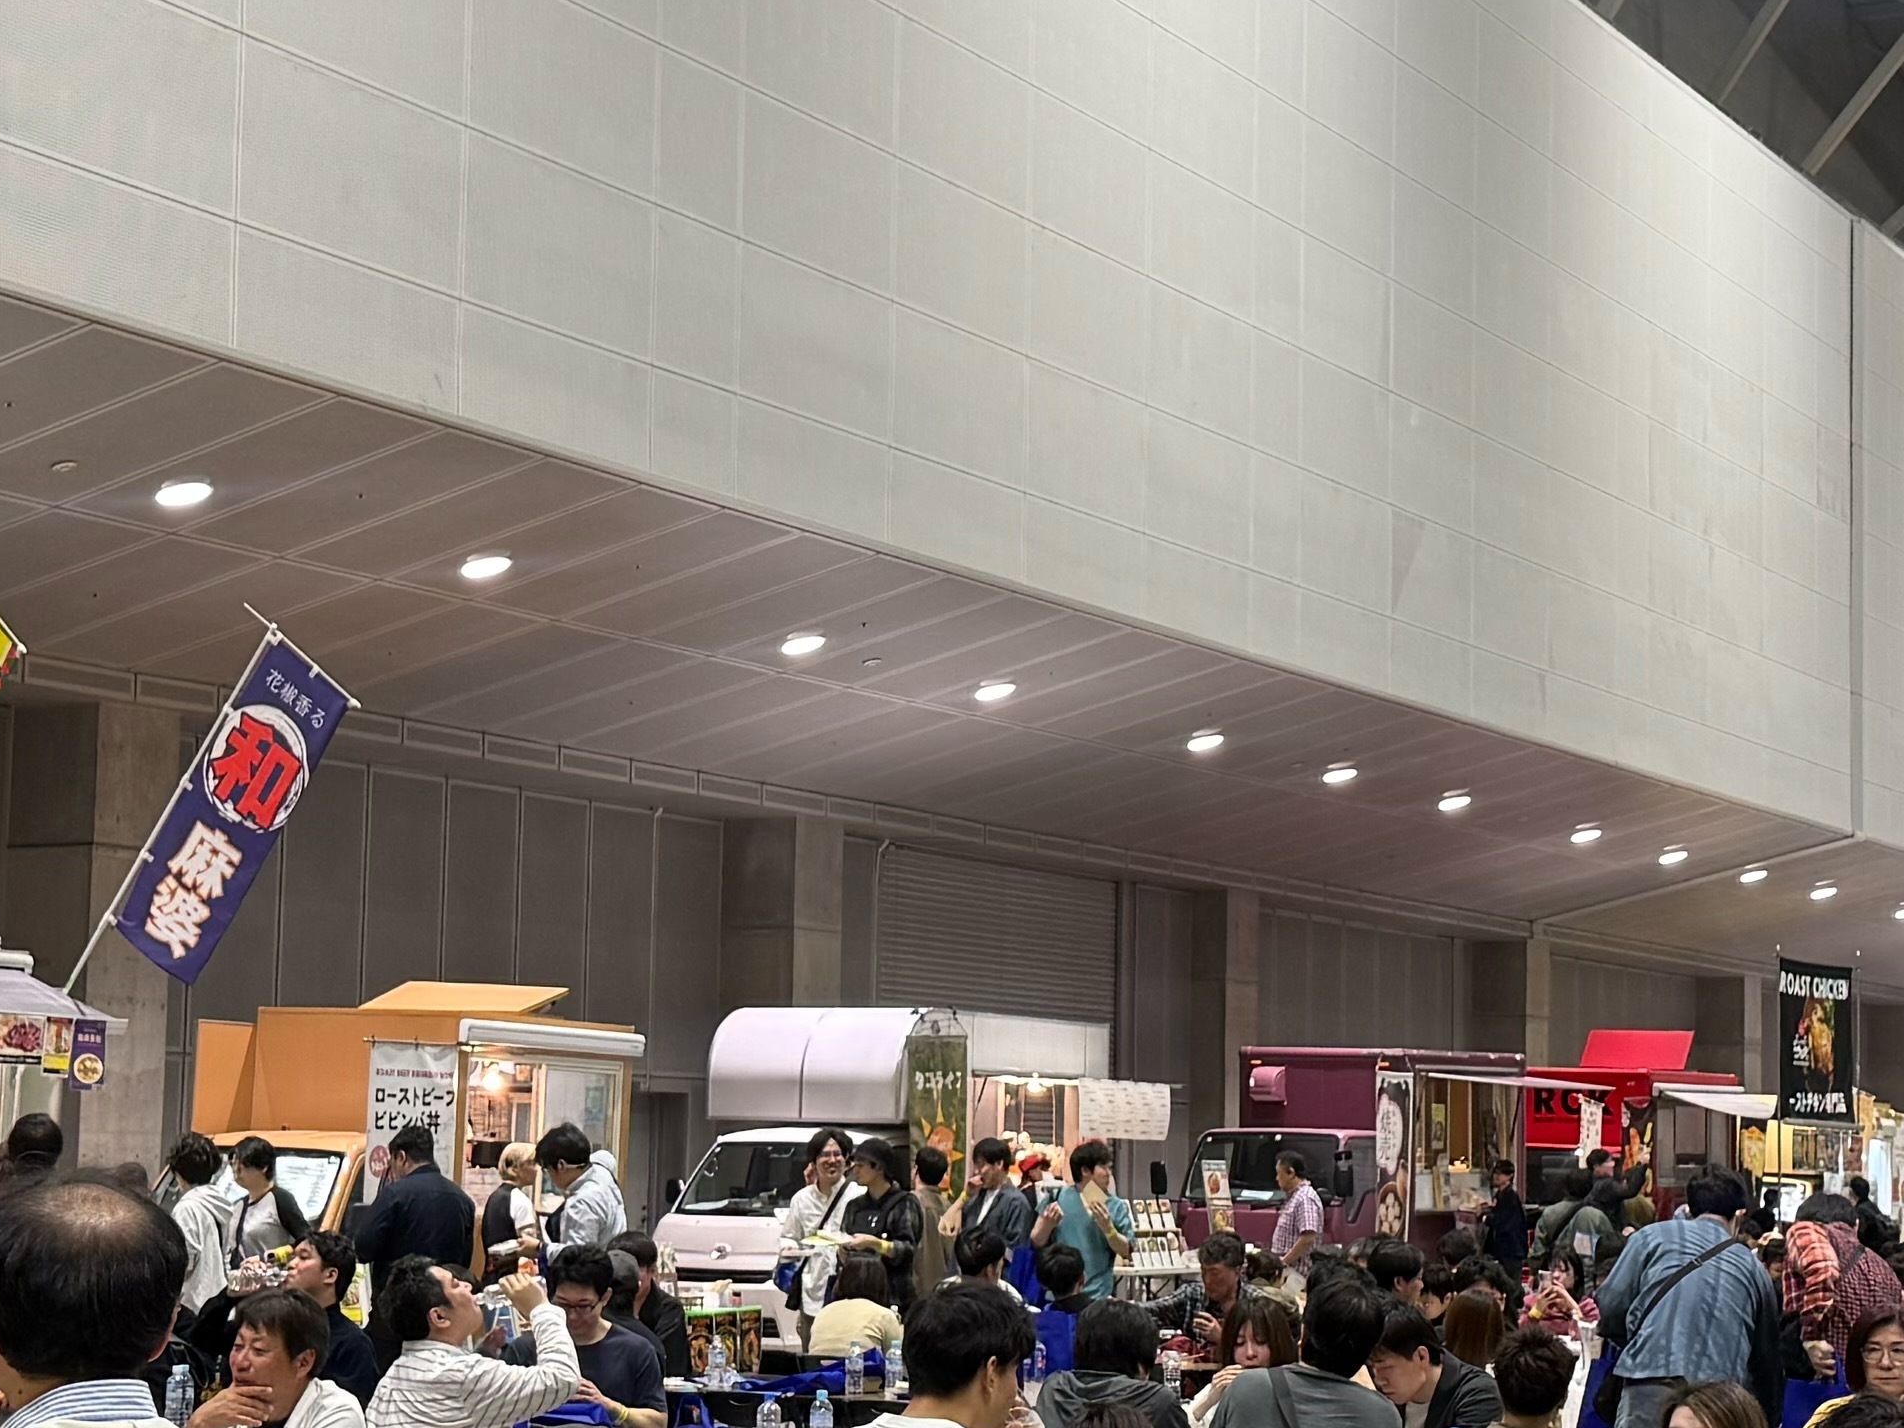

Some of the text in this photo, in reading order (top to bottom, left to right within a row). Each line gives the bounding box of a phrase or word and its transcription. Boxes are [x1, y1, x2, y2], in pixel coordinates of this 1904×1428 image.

[266, 668, 325, 729] 花椒香る
[1779, 970, 1811, 997] ROAST
[375, 1087, 455, 1108] ローストビーフ
[374, 1110, 441, 1134] ビビンバ丼
